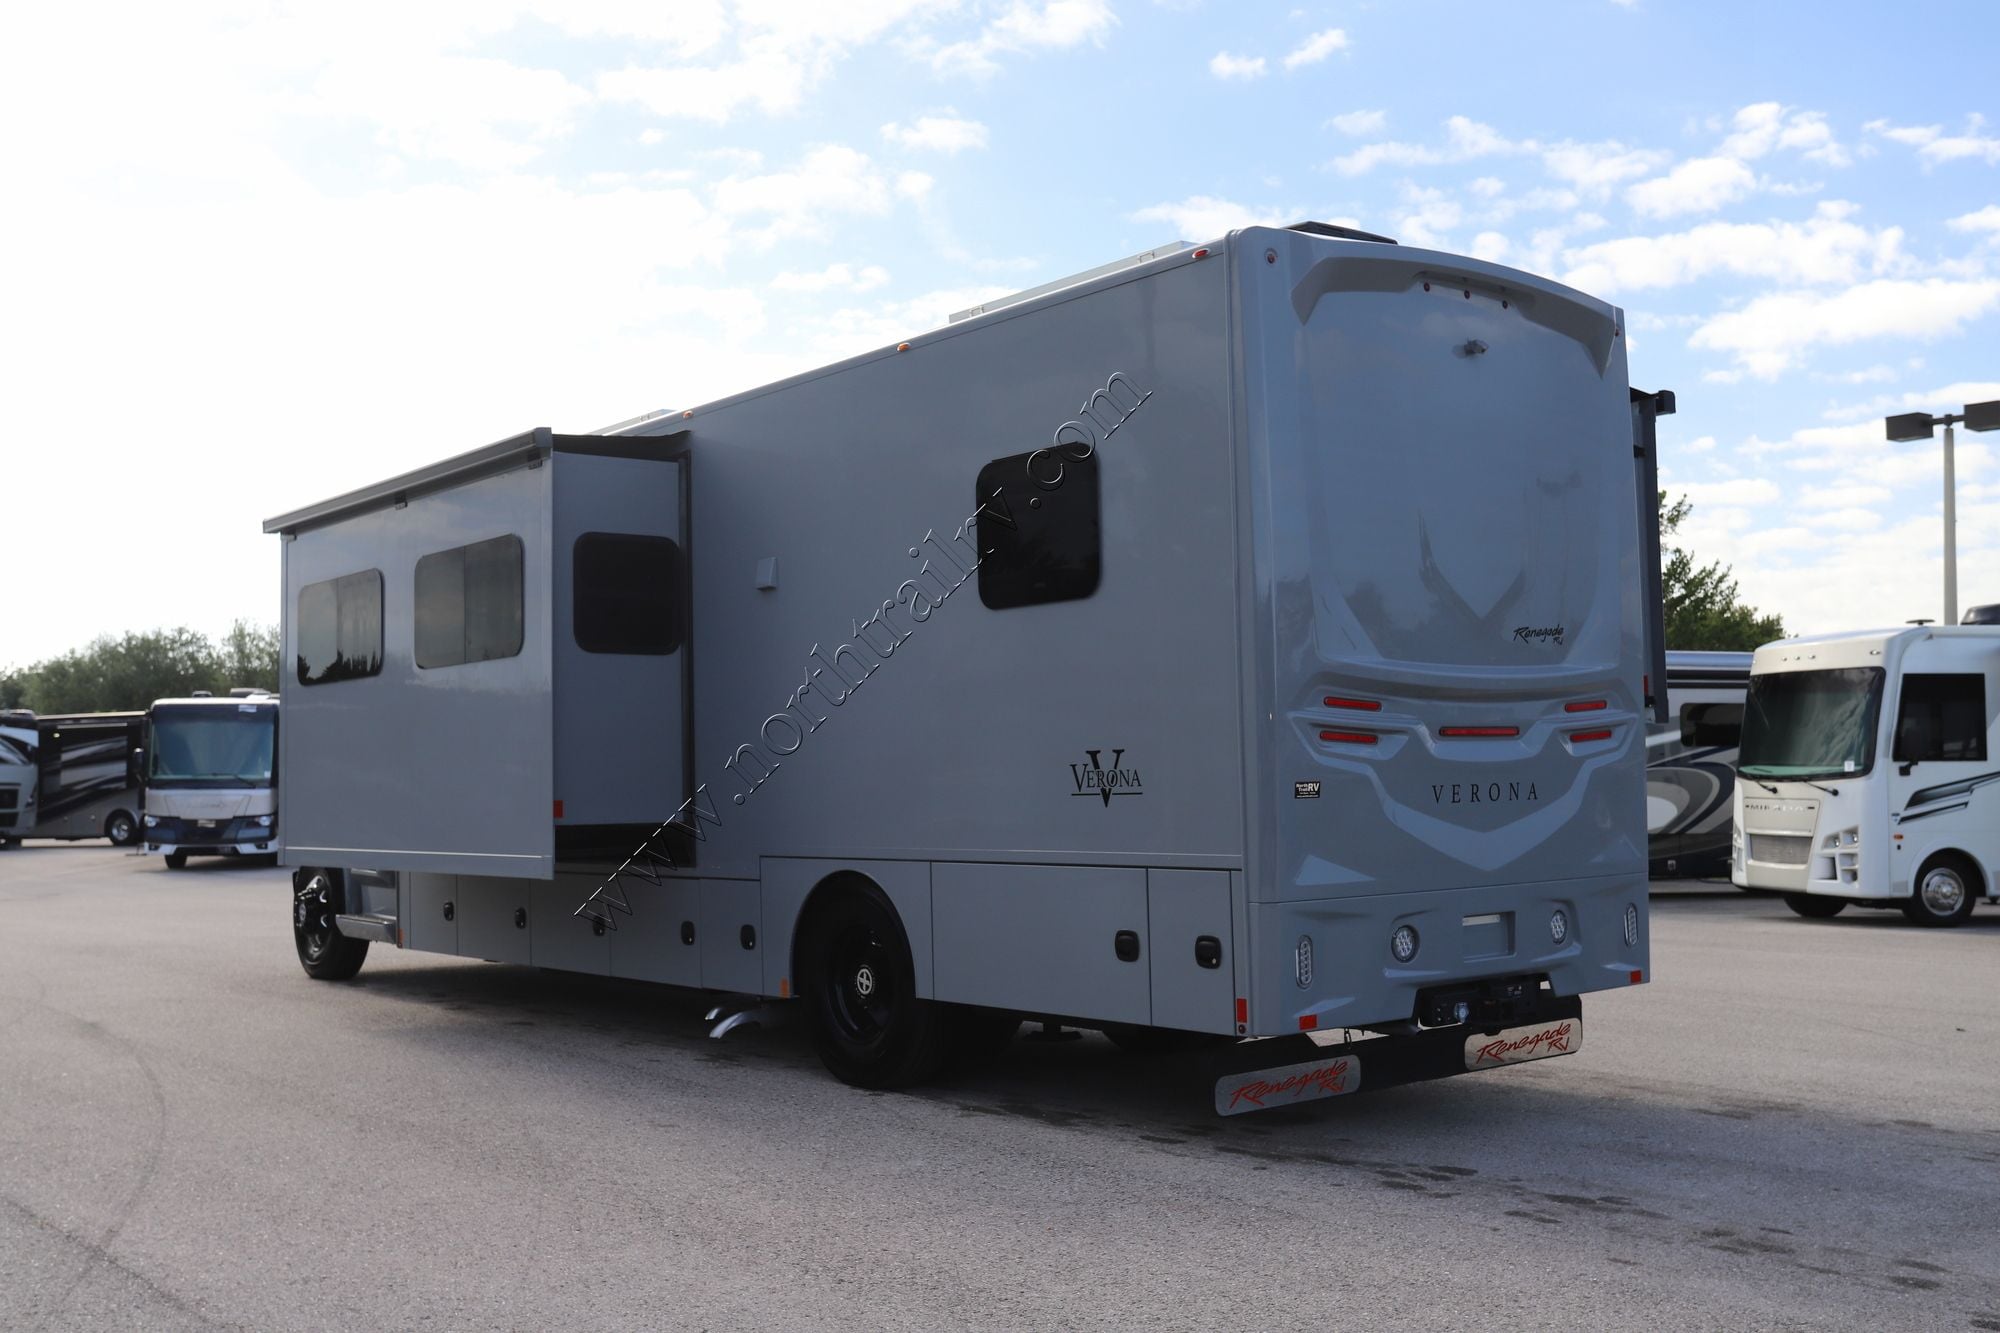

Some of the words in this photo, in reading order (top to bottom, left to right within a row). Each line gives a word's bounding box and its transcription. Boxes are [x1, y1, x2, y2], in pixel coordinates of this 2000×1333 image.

[1513, 624, 1564, 644] Renegade
[1069, 763, 1142, 793] VERONA
[1307, 782, 1320, 792] RV
[1432, 782, 1538, 804] VERONA
[1475, 1022, 1571, 1065] Renegade
[1547, 1036, 1570, 1052] RV
[1228, 1060, 1348, 1110] Renegade
[1318, 1076, 1346, 1094] RV
